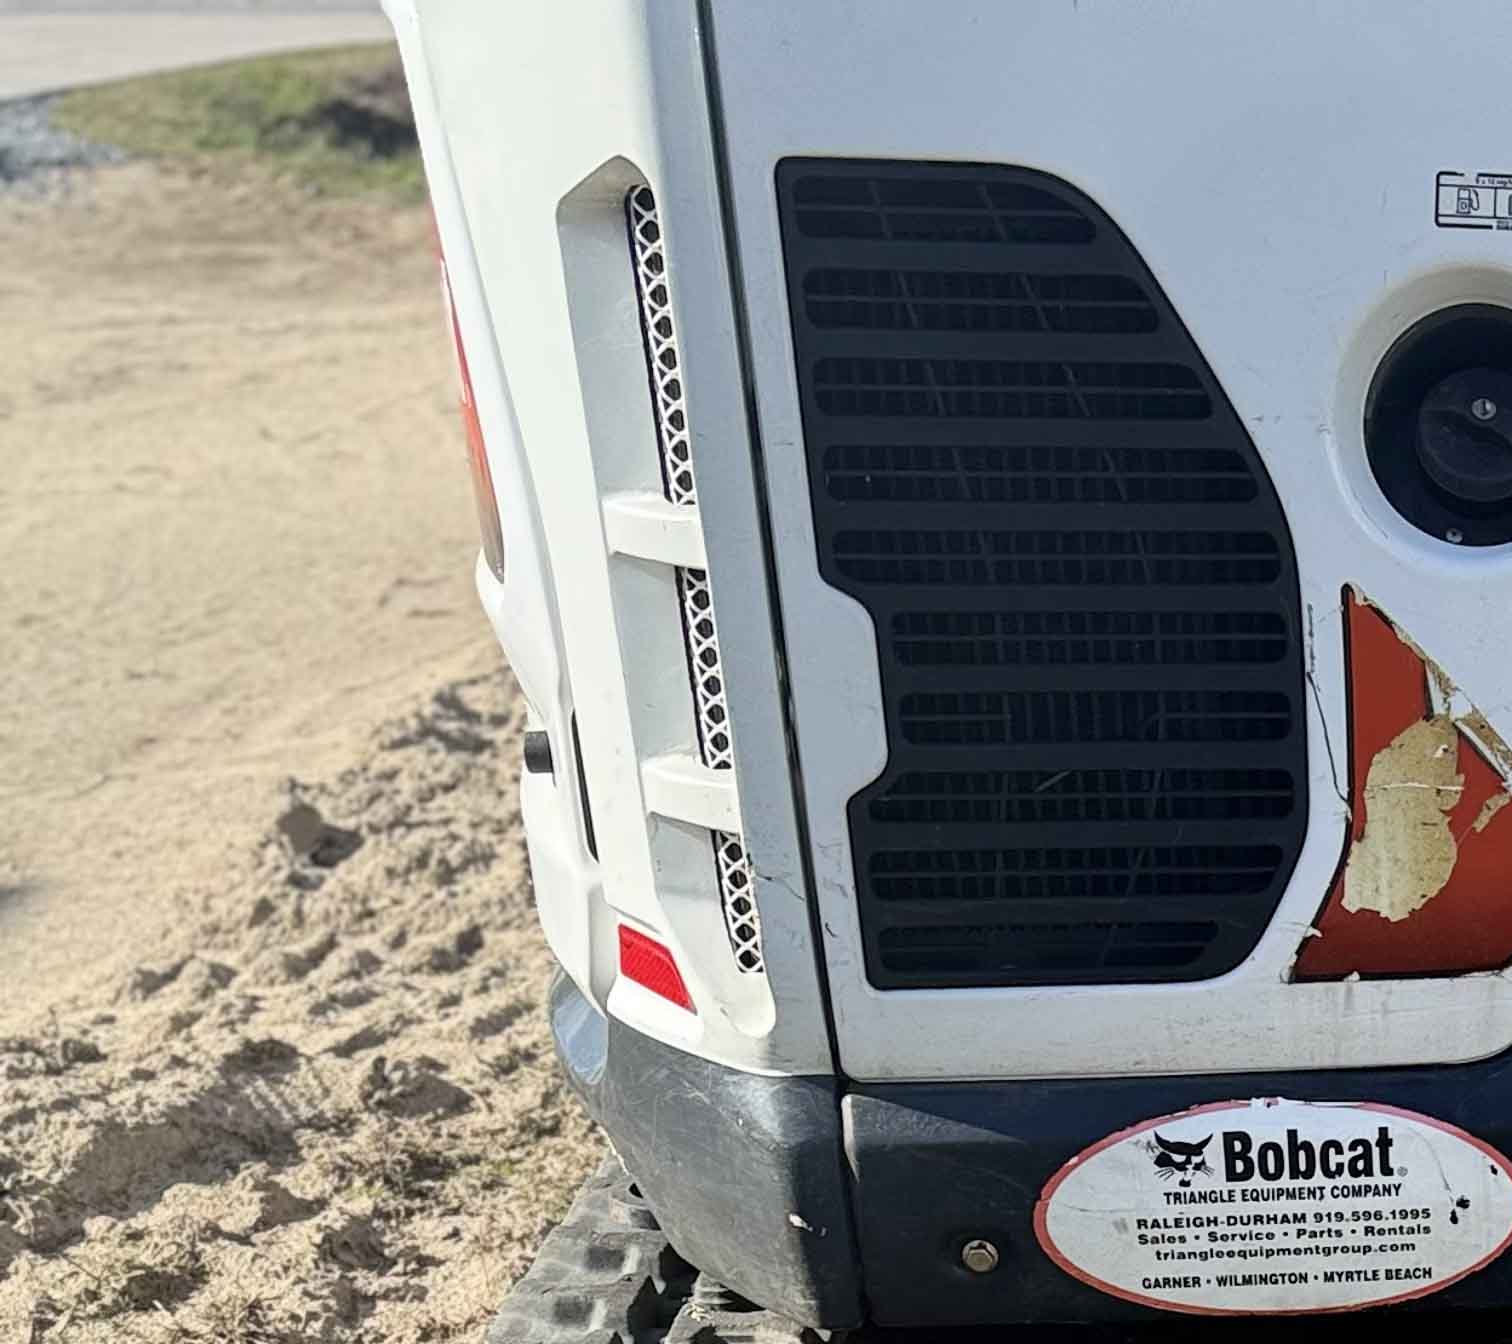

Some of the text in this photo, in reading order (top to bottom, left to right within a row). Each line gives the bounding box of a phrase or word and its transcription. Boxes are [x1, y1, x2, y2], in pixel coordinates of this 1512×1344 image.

[1222, 1126, 1394, 1183] Bobcat
[1163, 1183, 1402, 1206] TRIANGLE EQUIPMENT COMPANY
[1136, 1208, 1431, 1230] RALEIGH-DURHAM 919.596.1995
[1138, 1223, 1432, 1246] Sales Service Parts Rentals
[1155, 1242, 1416, 1262] triangleequipmentgroup.com
[1142, 1266, 1433, 1290] GARNER WILMINGTON MYRTLE BEACH
